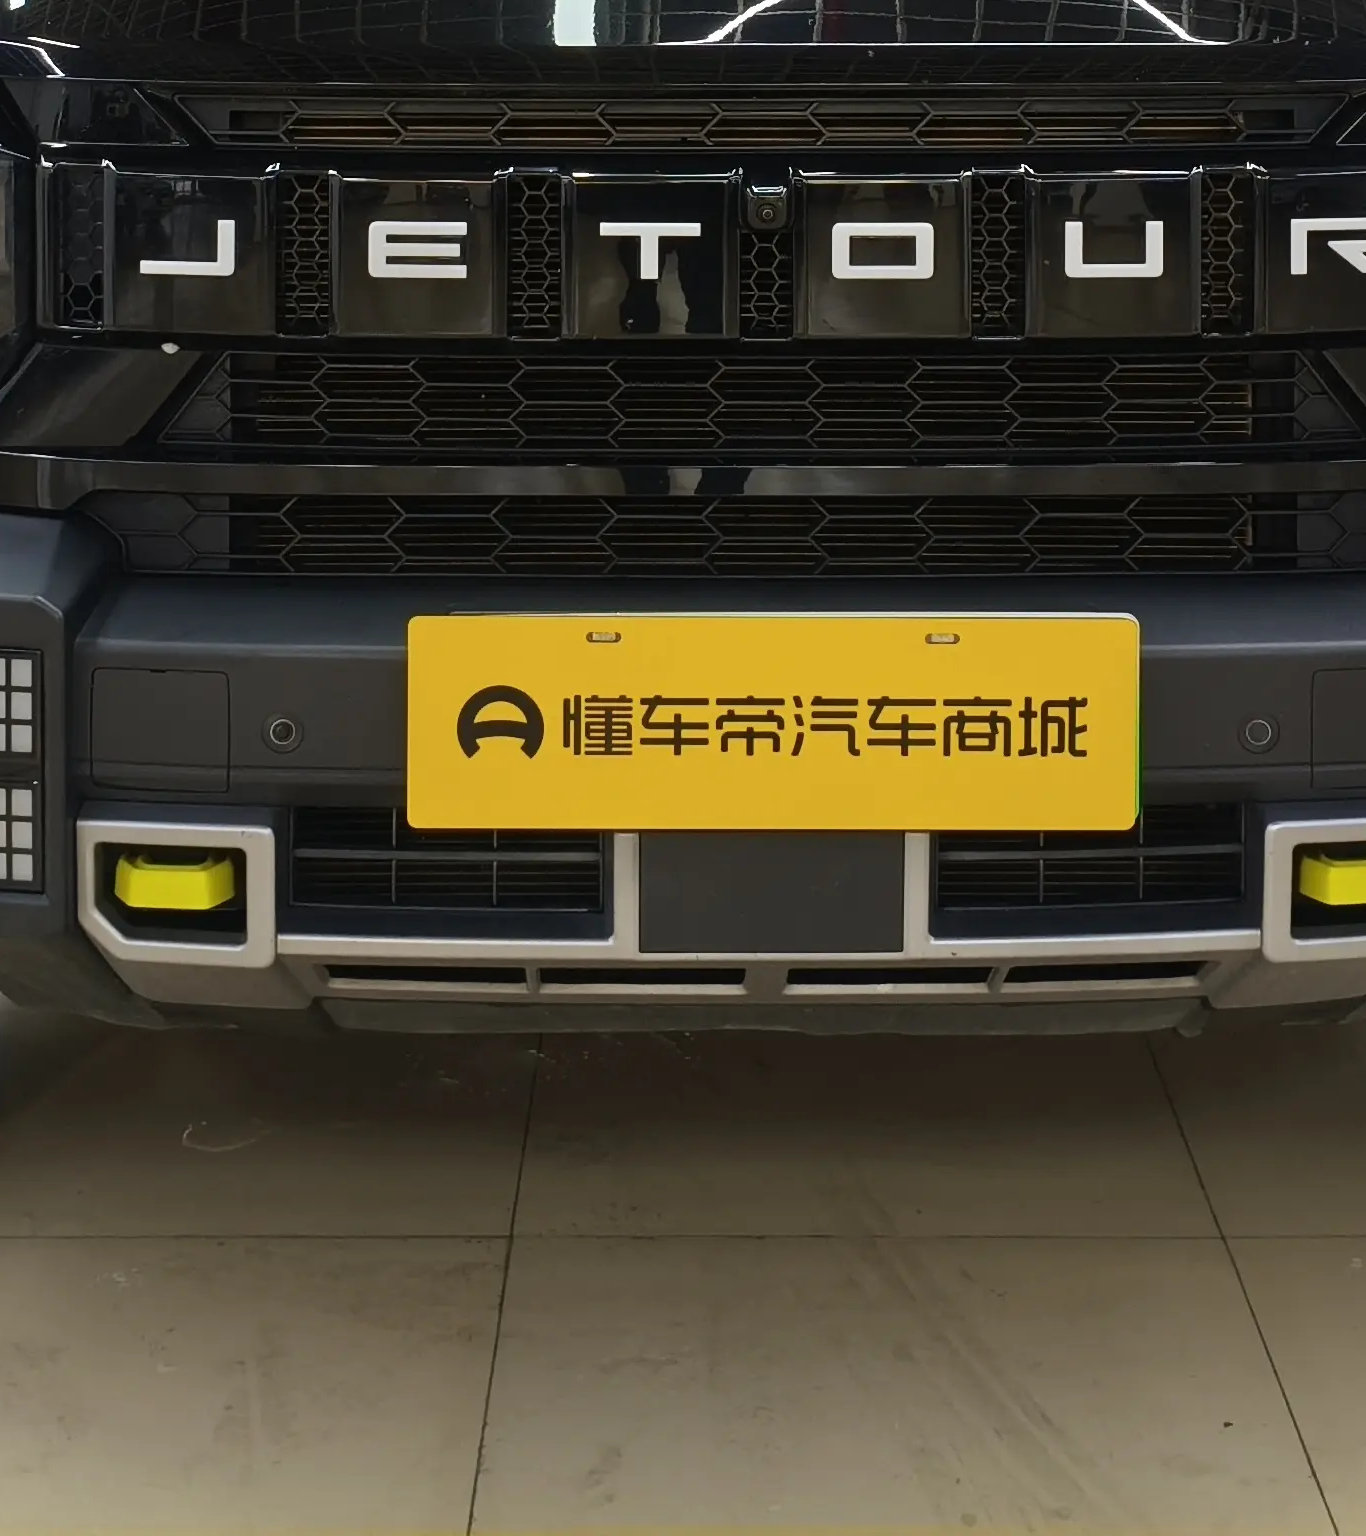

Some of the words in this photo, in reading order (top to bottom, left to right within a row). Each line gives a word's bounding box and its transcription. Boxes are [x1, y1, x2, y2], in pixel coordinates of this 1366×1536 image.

[562, 694, 1089, 758] 懂车帝汽车商城
